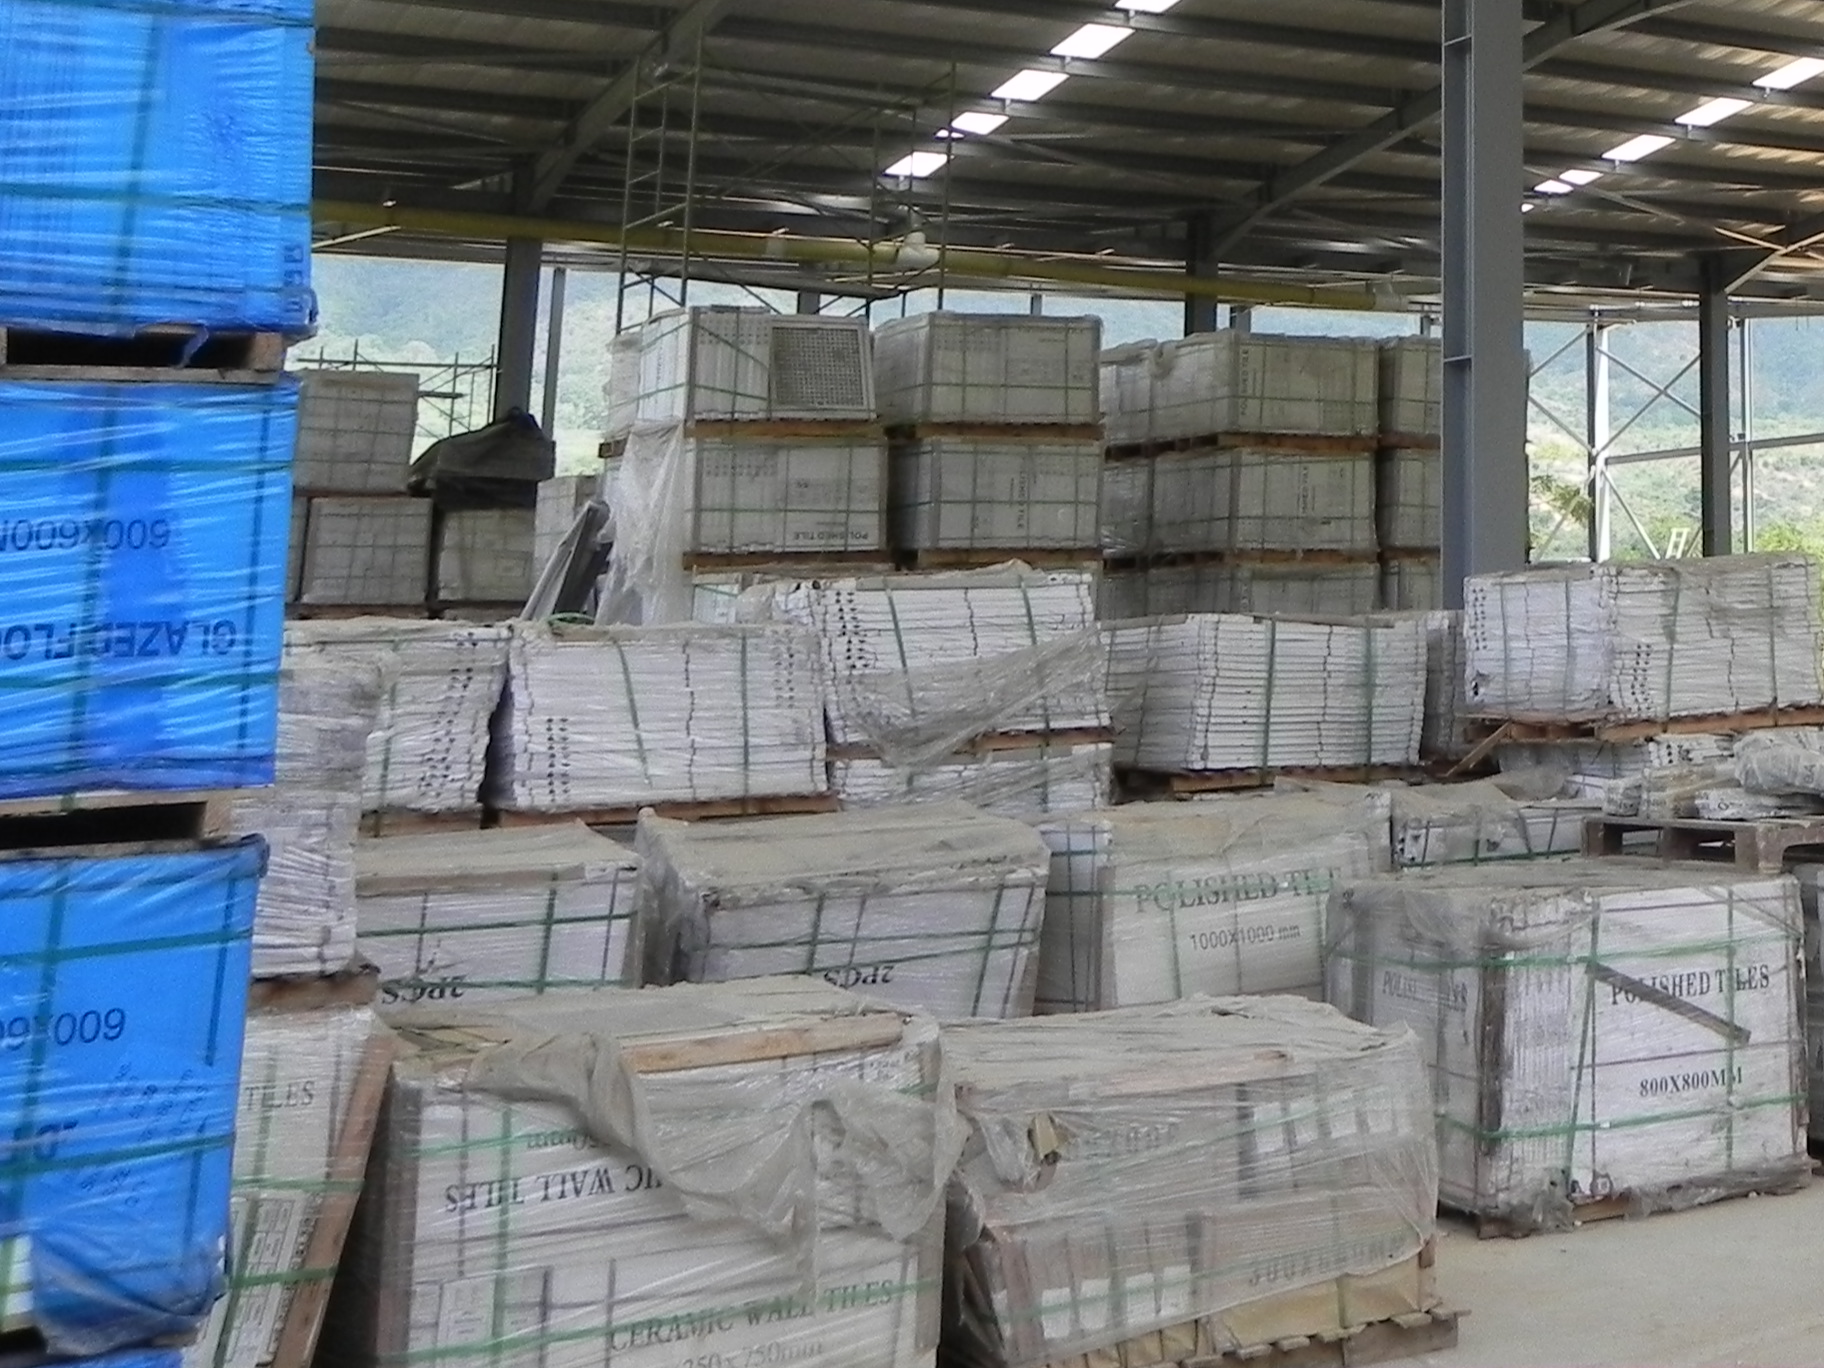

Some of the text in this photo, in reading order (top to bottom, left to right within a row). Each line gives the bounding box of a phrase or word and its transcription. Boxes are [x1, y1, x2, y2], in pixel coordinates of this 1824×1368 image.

[1189, 924, 1275, 951] 1000X1000
[1611, 963, 1770, 1006] POISHED TLES
[445, 1177, 526, 1213] TILES
[536, 1167, 616, 1203] WALL
